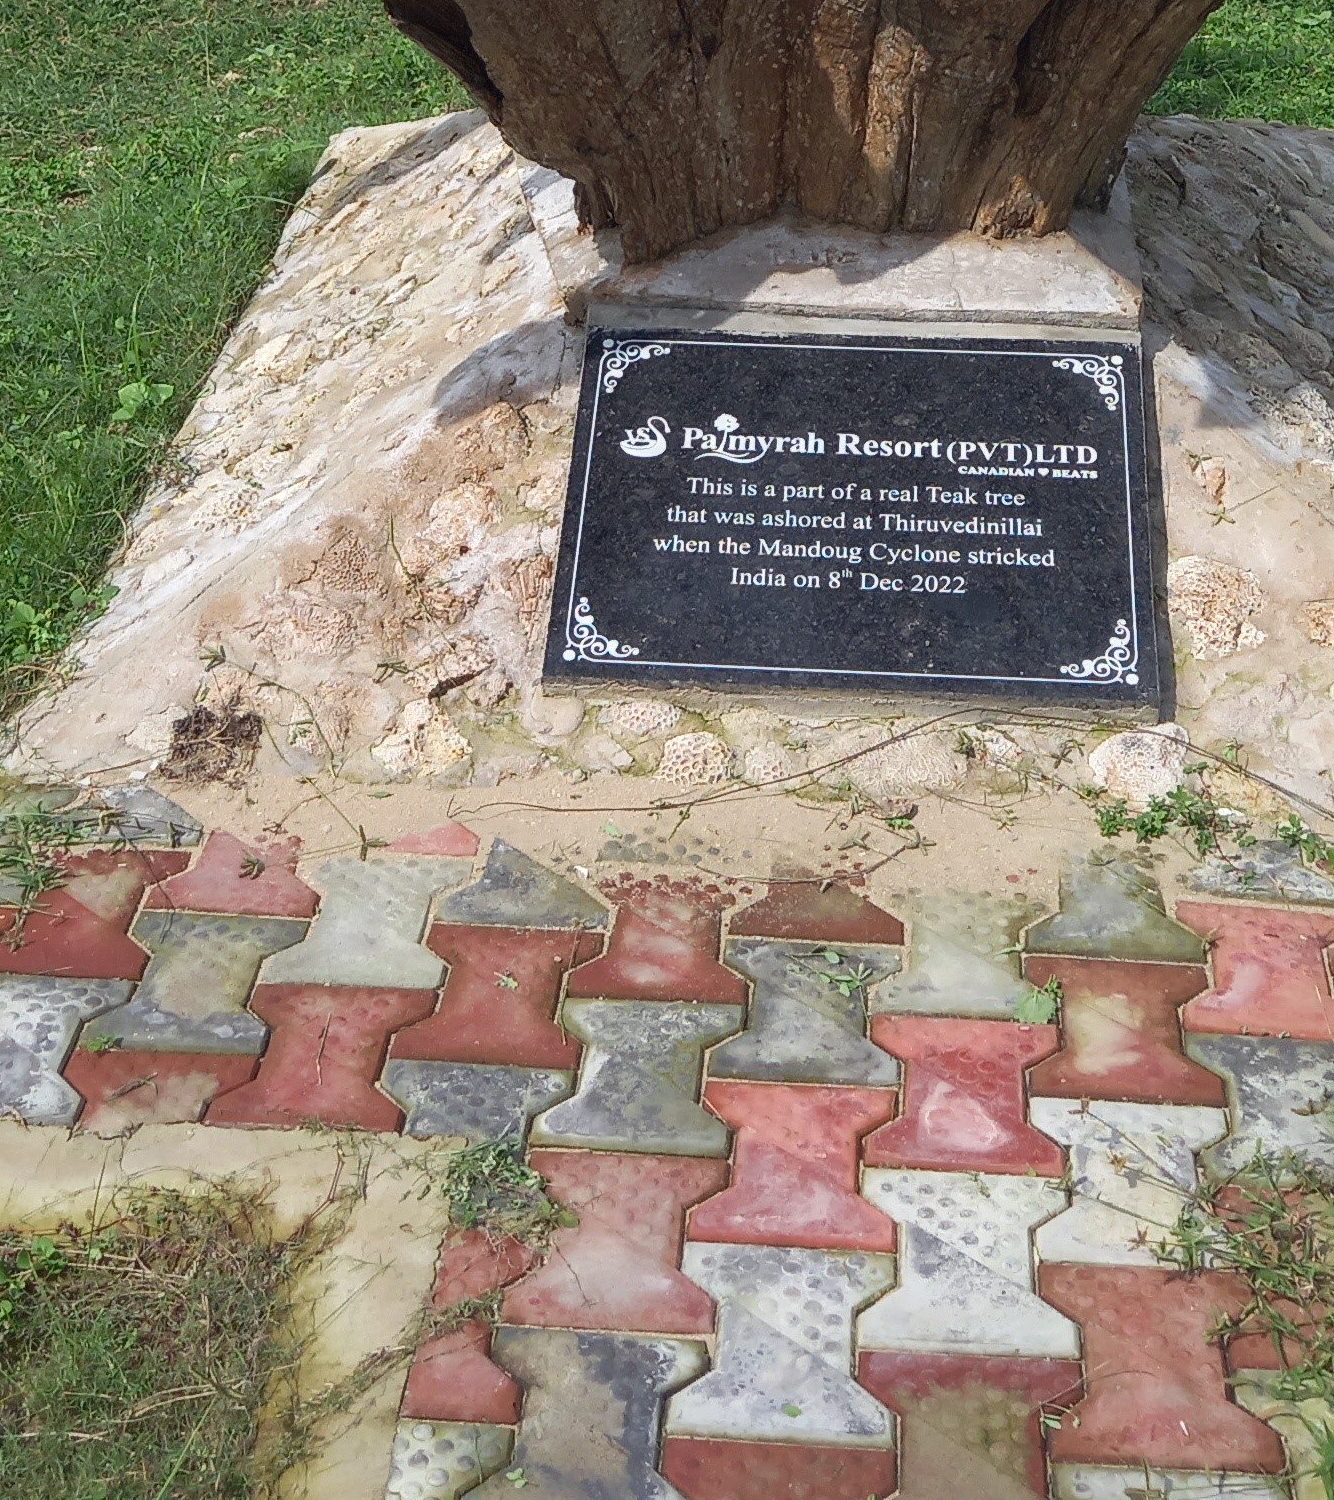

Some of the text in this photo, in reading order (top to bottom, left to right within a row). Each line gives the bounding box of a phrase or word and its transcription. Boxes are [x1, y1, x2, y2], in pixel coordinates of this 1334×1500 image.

[680, 413, 825, 464] Palmyrah
[835, 432, 943, 459] Resort
[957, 465, 1099, 479] CANADIAN BEATS
[686, 476, 1026, 506] This is a part of a real Teak tree
[667, 504, 1043, 537] that was ashored at Thiruvedinillai
[652, 534, 1055, 567] when the Mandoug Cyclone stricked
[730, 567, 967, 594] India on 8th Dec 2022
